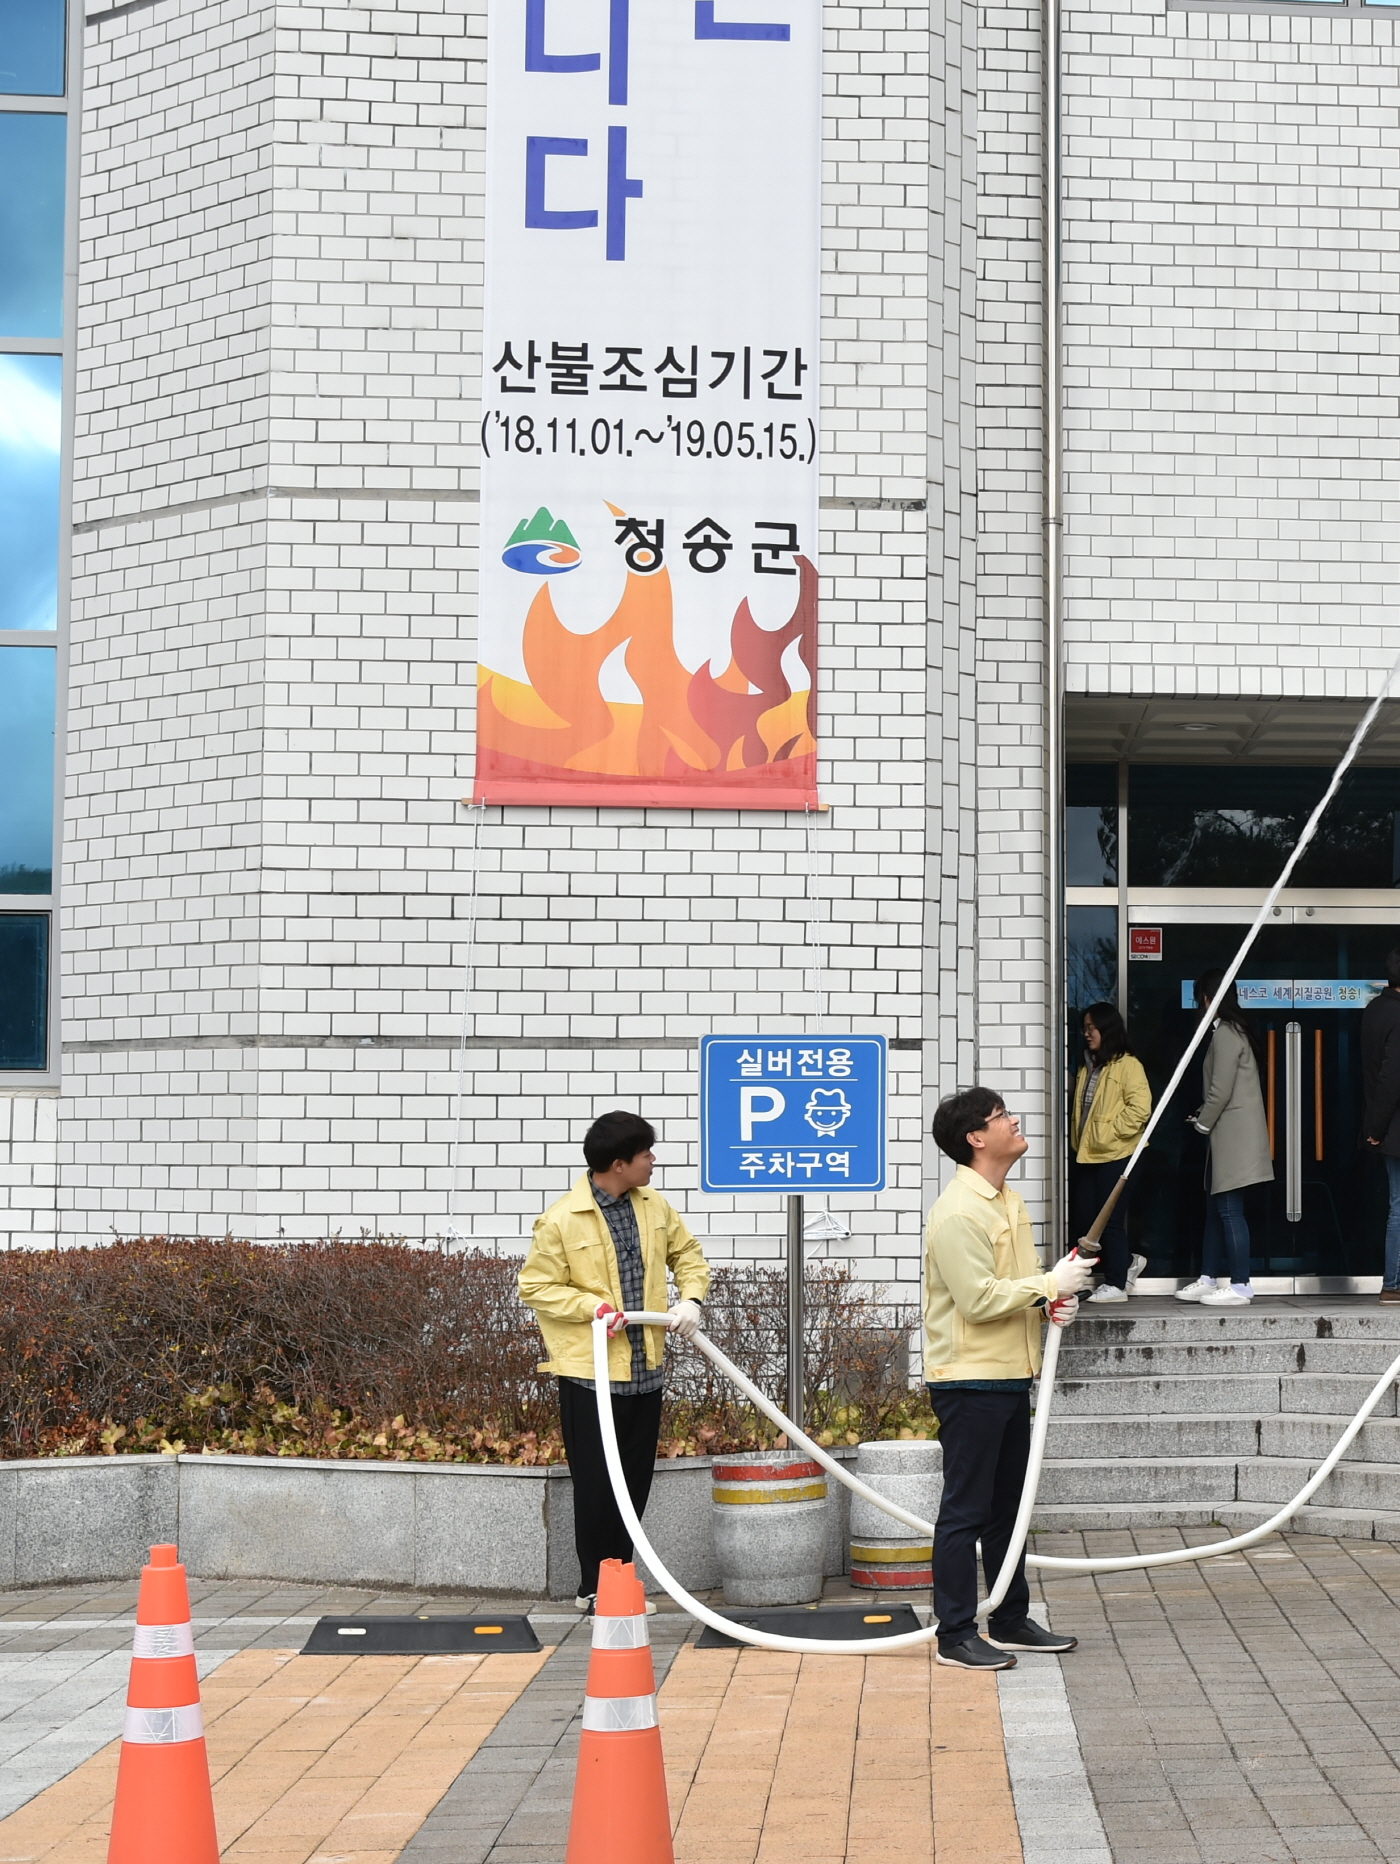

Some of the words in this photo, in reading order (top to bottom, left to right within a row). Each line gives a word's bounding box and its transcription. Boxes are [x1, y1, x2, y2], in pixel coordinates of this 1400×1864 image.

[492, 340, 808, 400] 산불조심기간
[614, 517, 800, 576] 청송군
[1135, 936, 1156, 945] 에스원
[1237, 987, 1268, 1000] 네스코
[1338, 987, 1361, 1000] 청송!
[736, 1047, 854, 1077] 실버전용
[740, 1086, 786, 1141] P
[738, 1151, 850, 1179] 주차구역
